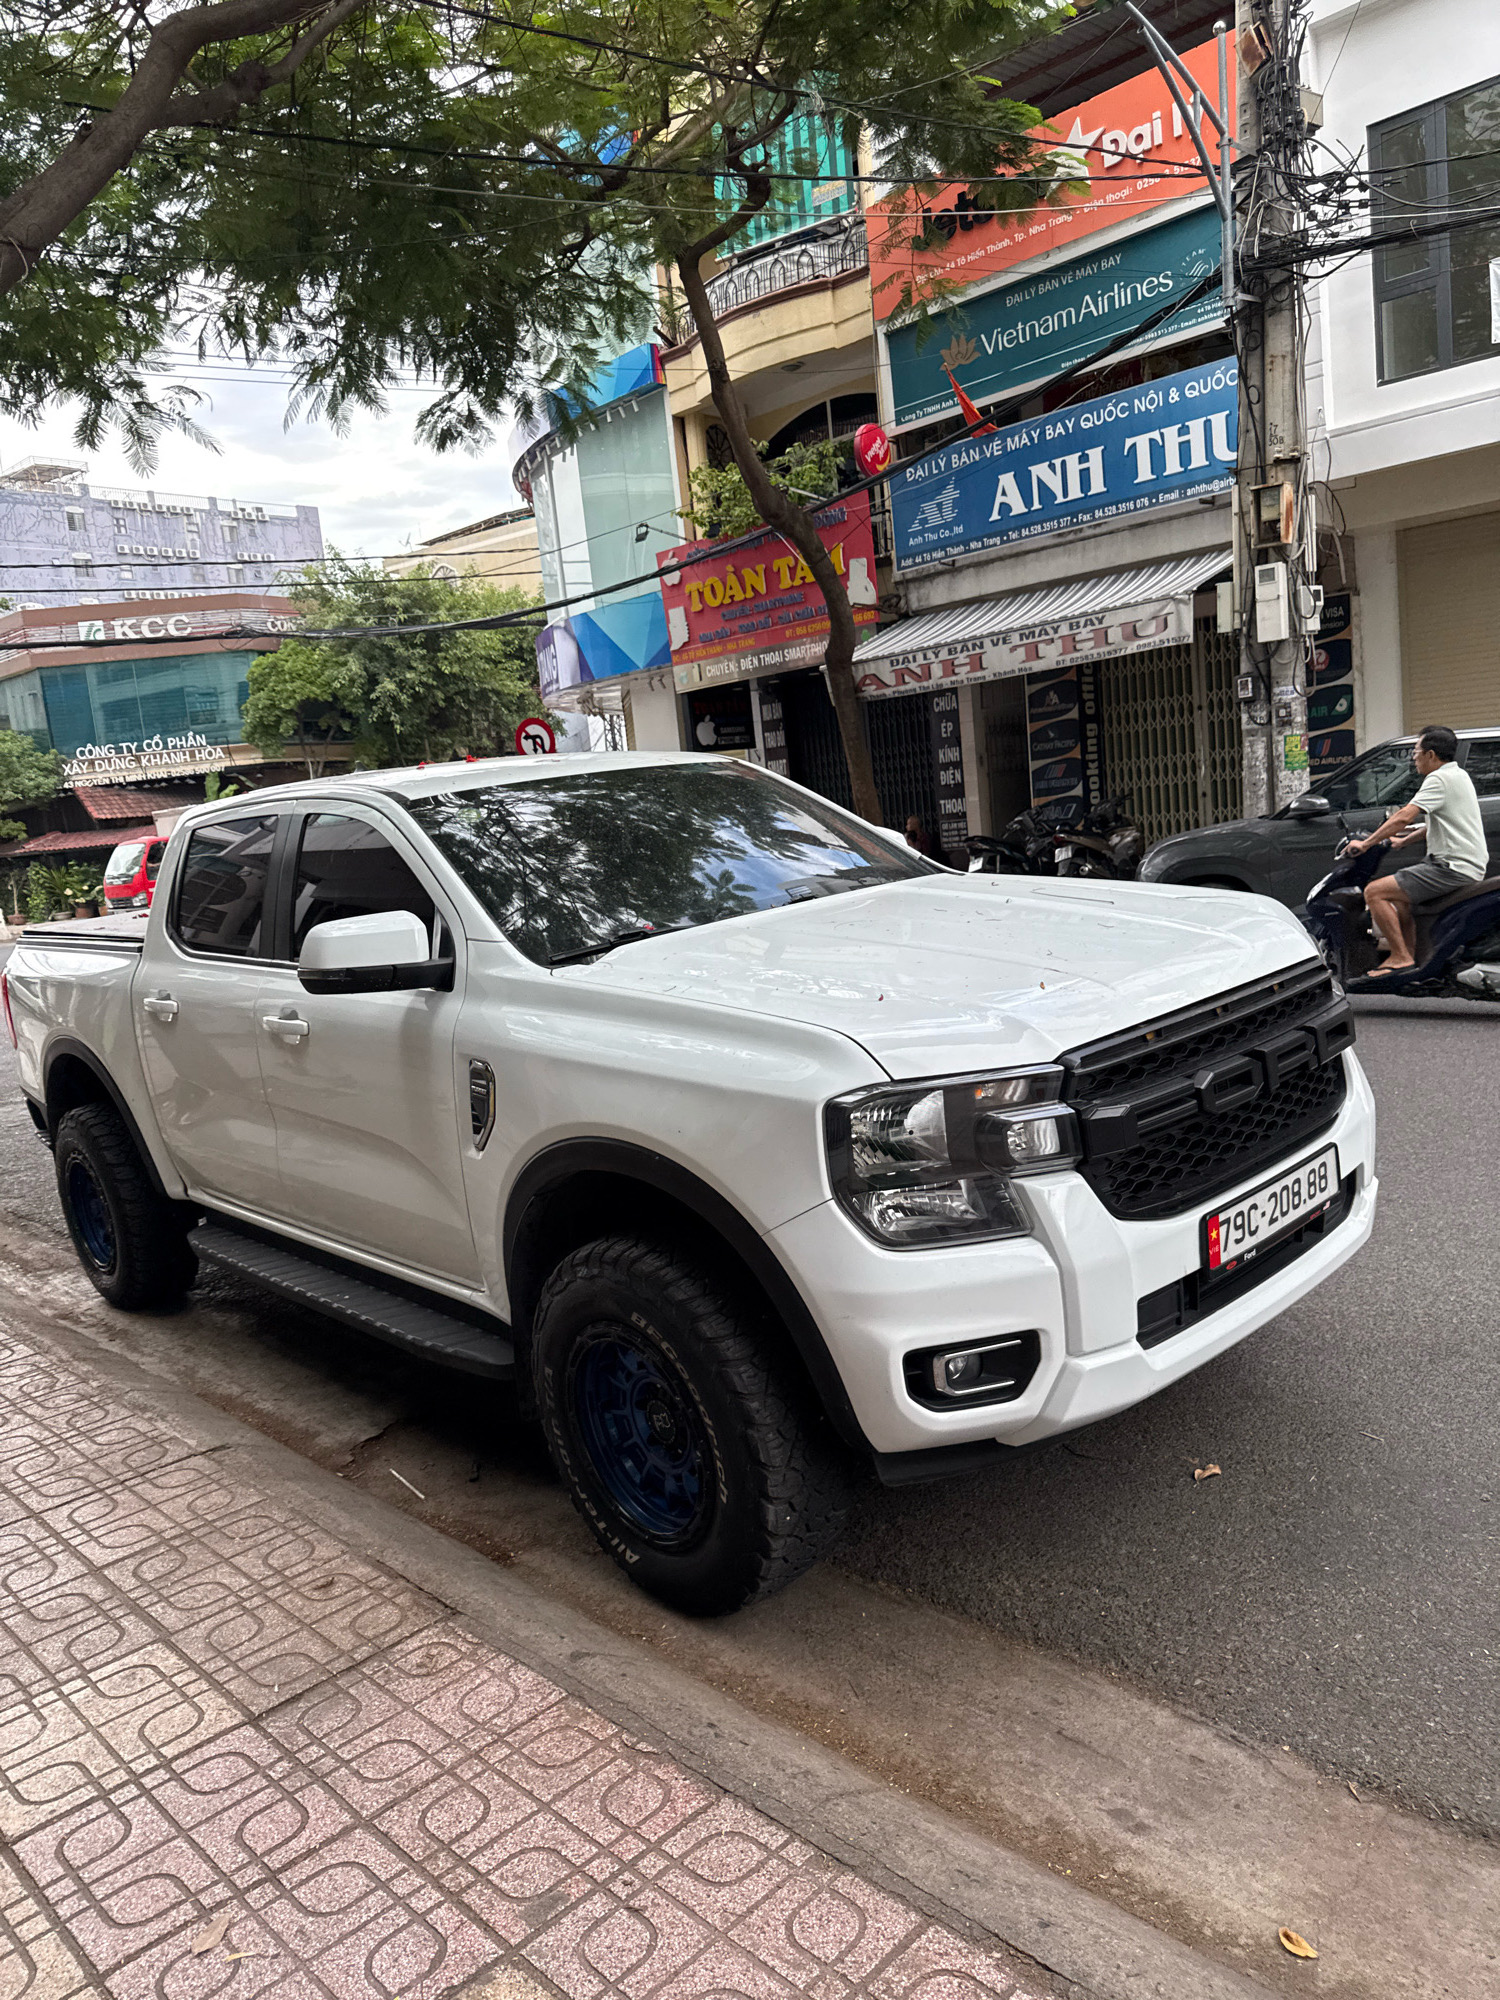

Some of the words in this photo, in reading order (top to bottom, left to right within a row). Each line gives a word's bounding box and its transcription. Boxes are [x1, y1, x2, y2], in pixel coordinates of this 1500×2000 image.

[1101, 111, 1163, 168] Đại
[957, 256, 966, 266] Tô
[986, 236, 1013, 254] Thành,
[1014, 231, 1027, 243] Tp.
[1029, 223, 1046, 237] Nha
[1048, 213, 1072, 229] Trang
[1006, 290, 1023, 307] ĐẠI
[1025, 285, 1037, 300] LÝ
[1039, 277, 1060, 295] BÁN
[1061, 270, 1074, 285] VÉ
[1075, 261, 1099, 281] MÁY
[1100, 253, 1123, 272] BAY
[906, 463, 929, 482] ĐẠI
[932, 453, 946, 475] LÝ
[951, 446, 980, 469] BÁN
[983, 437, 1002, 459] VÉ
[1007, 426, 1040, 452] MÁY
[1045, 417, 1076, 441] BAY
[1080, 398, 1129, 430] QUỐC
[1134, 388, 1163, 414] NỘI
[1168, 386, 1180, 404] &
[1185, 366, 1238, 398] QUỐC
[989, 445, 1108, 522] ANH
[909, 533, 923, 547] Anh
[924, 529, 938, 542] Thu
[915, 554, 922, 563] 44
[970, 538, 982, 548] Nha
[983, 535, 1000, 547] Trang
[1008, 530, 1020, 540] Tel:
[1078, 511, 1093, 523] Fax:
[1159, 489, 1179, 503] Email
[685, 564, 766, 613] TOÀN
[110, 615, 192, 639] KCC
[1325, 605, 1345, 618] VISA
[740, 651, 759, 673] ĐIỆN
[759, 646, 783, 667] THOẠI
[784, 638, 829, 662] SMARTPHO
[857, 651, 988, 694] ANH
[1009, 612, 1175, 665] THU
[889, 654, 917, 669] ĐẠI
[923, 648, 941, 662] LÝ
[947, 639, 985, 657] BÁN
[990, 633, 1012, 648] VÉ
[1019, 623, 1061, 642] MÁY
[1069, 615, 1107, 632] BAY
[966, 674, 986, 684] Trang
[940, 719, 954, 738] ÉP
[62, 760, 89, 776] XÂY
[94, 754, 137, 775] DỰNG
[141, 748, 191, 767] KHÁNH
[196, 744, 226, 761] HÒA
[76, 743, 116, 760] CÔNG
[119, 741, 138, 755] TY
[143, 733, 163, 752] CỔ
[167, 731, 207, 750] PHẦN
[938, 745, 960, 764] KÍNH
[940, 767, 962, 788] ĐIỆN
[939, 797, 967, 817] THOẠI
[1219, 1161, 1328, 1253] 79C-208.88
[1209, 1244, 1220, 1256] VIE
[1244, 1249, 1256, 1260] Ford
